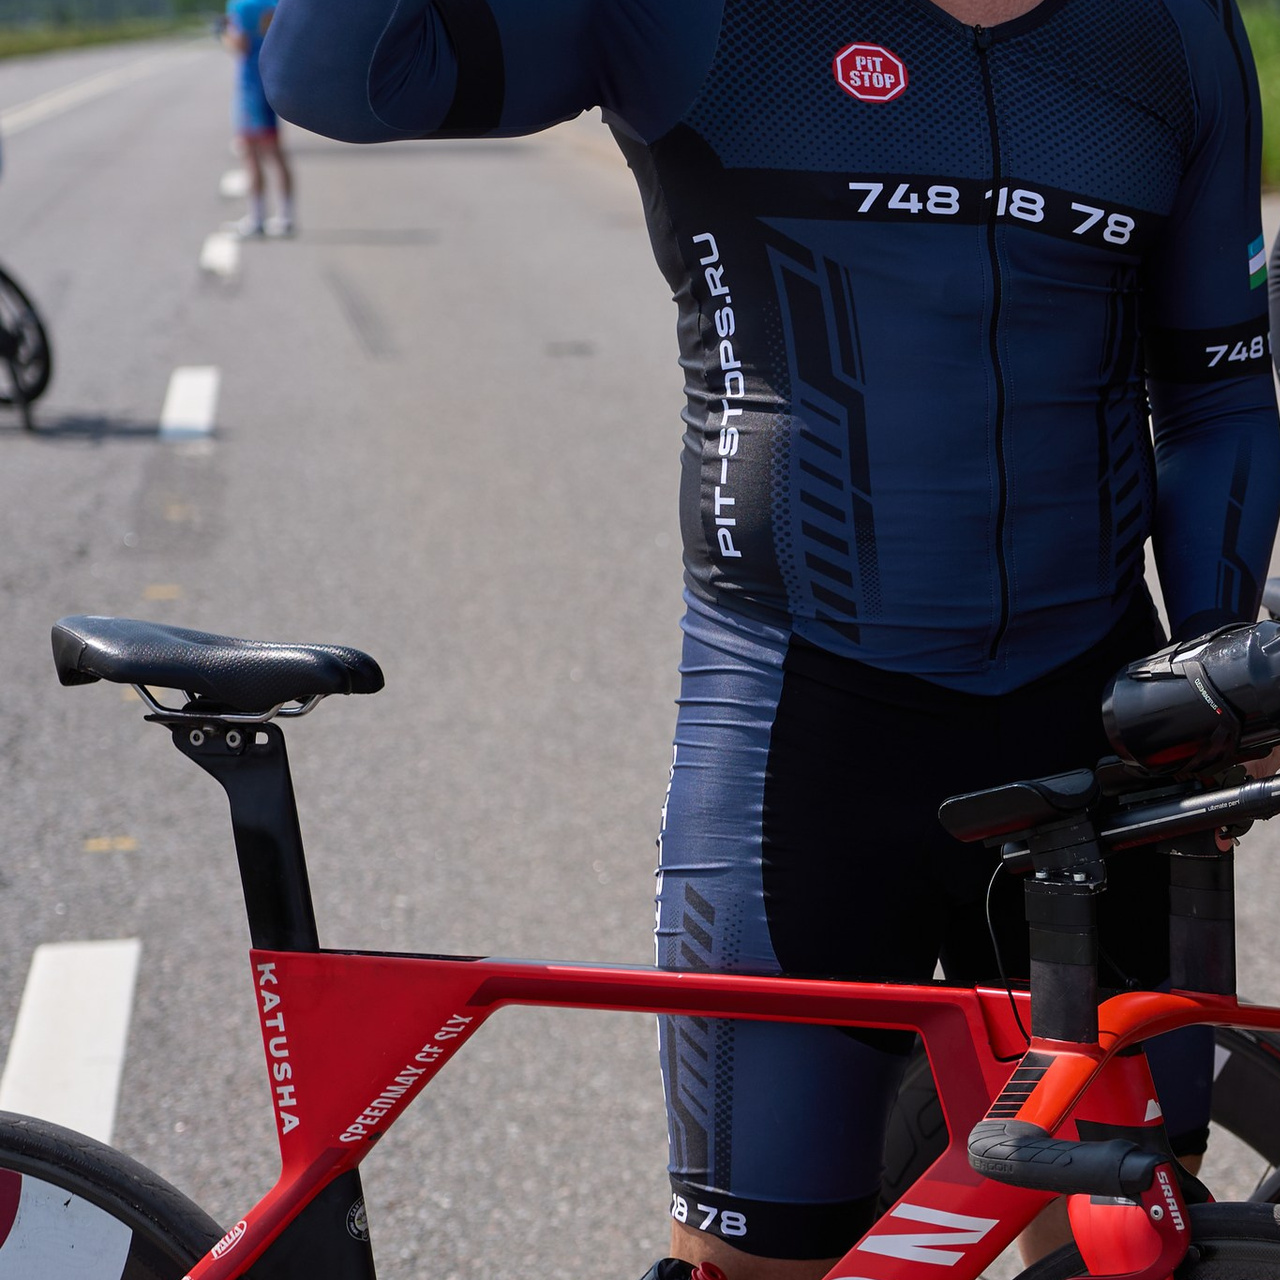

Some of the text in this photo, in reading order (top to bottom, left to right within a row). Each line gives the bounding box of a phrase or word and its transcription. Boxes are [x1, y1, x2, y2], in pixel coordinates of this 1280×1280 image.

[849, 71, 896, 89] STOP
[848, 182, 1136, 245] 748 18 78
[1205, 336, 1264, 368] 748
[692, 232, 743, 558] PIT-STOPS.RU
[257, 963, 300, 1135] KATUSHA
[339, 1065, 427, 1143] SPEEDMAX
[434, 1013, 474, 1041] SLX
[671, 1193, 748, 1237] 18 78
[1157, 1171, 1185, 1231] SRAM
[211, 1224, 243, 1259] ITALIA
